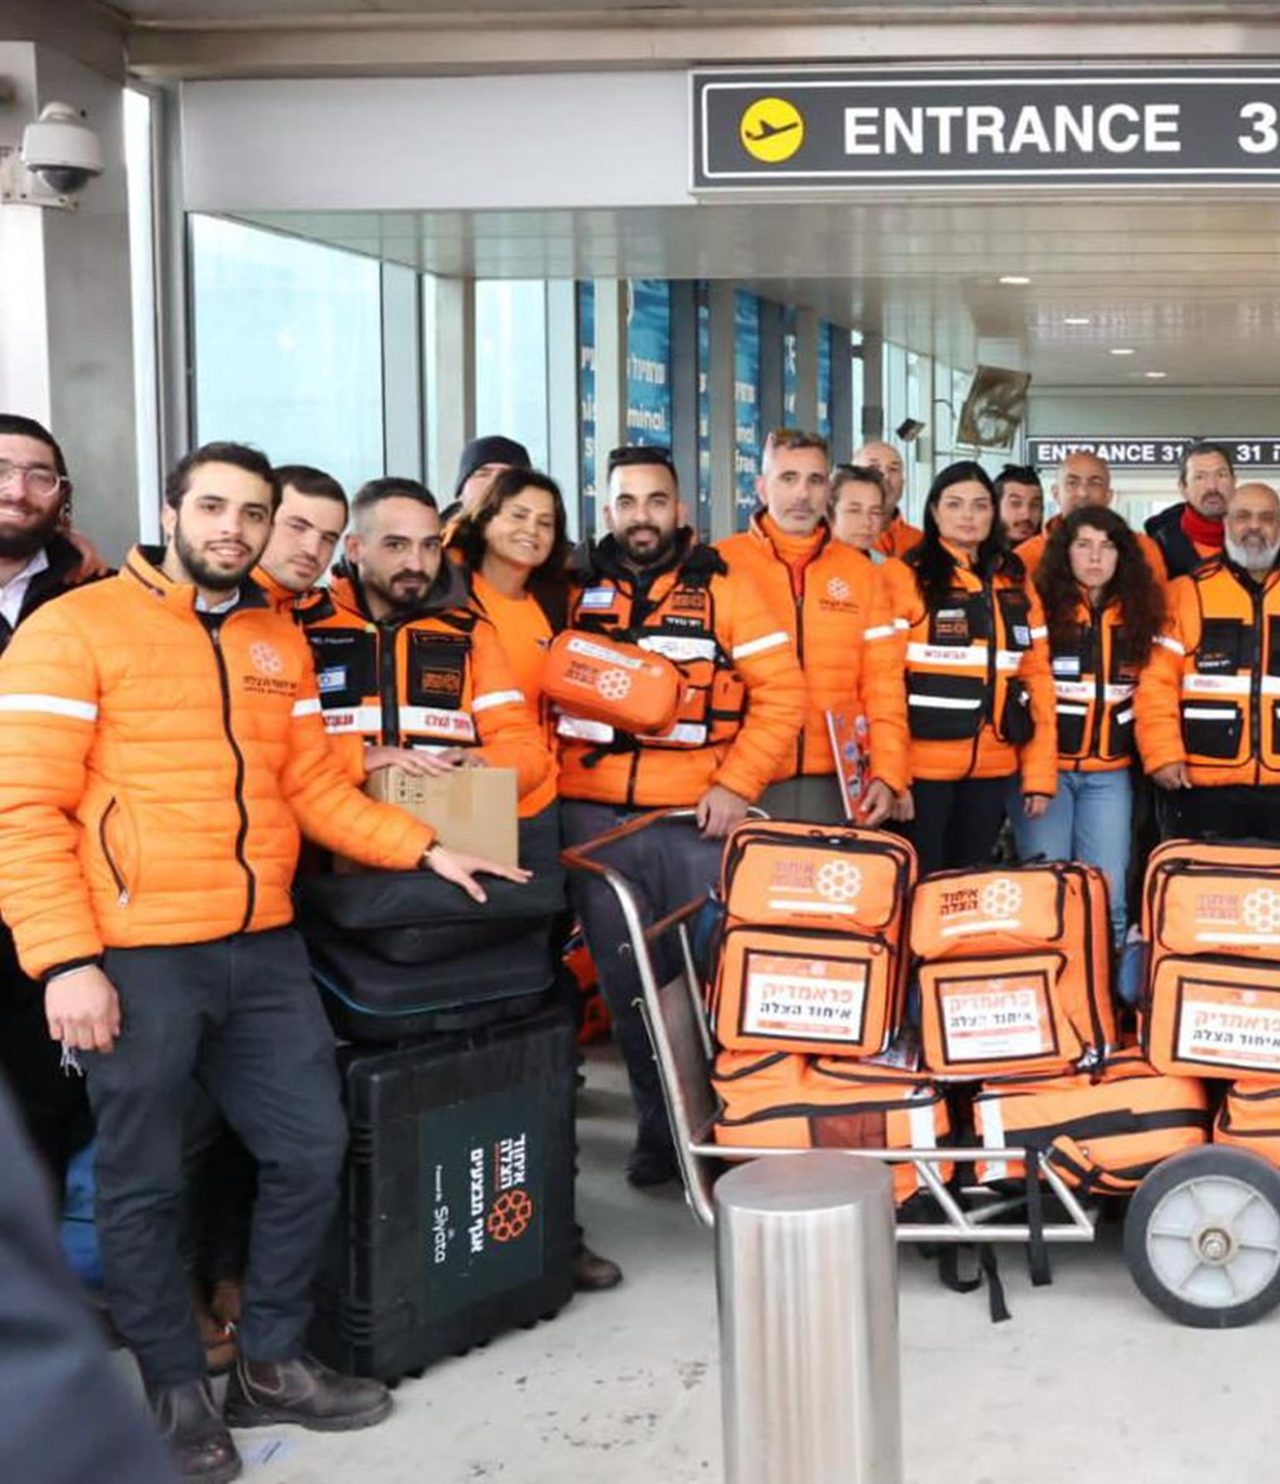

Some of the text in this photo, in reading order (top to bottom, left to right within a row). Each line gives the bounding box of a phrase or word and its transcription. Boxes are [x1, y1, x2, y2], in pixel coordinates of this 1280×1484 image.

[844, 103, 1181, 155] ENTRANCE
[1161, 444, 1184, 461] 31
[1236, 445, 1261, 462] 31
[759, 1001, 853, 1020] איחוד הצלה
[1192, 1028, 1235, 1044] הצלה
[500, 1138, 513, 1190] הצלה
[513, 1132, 526, 1185] איחוד
[467, 1218, 484, 1254] אגף
